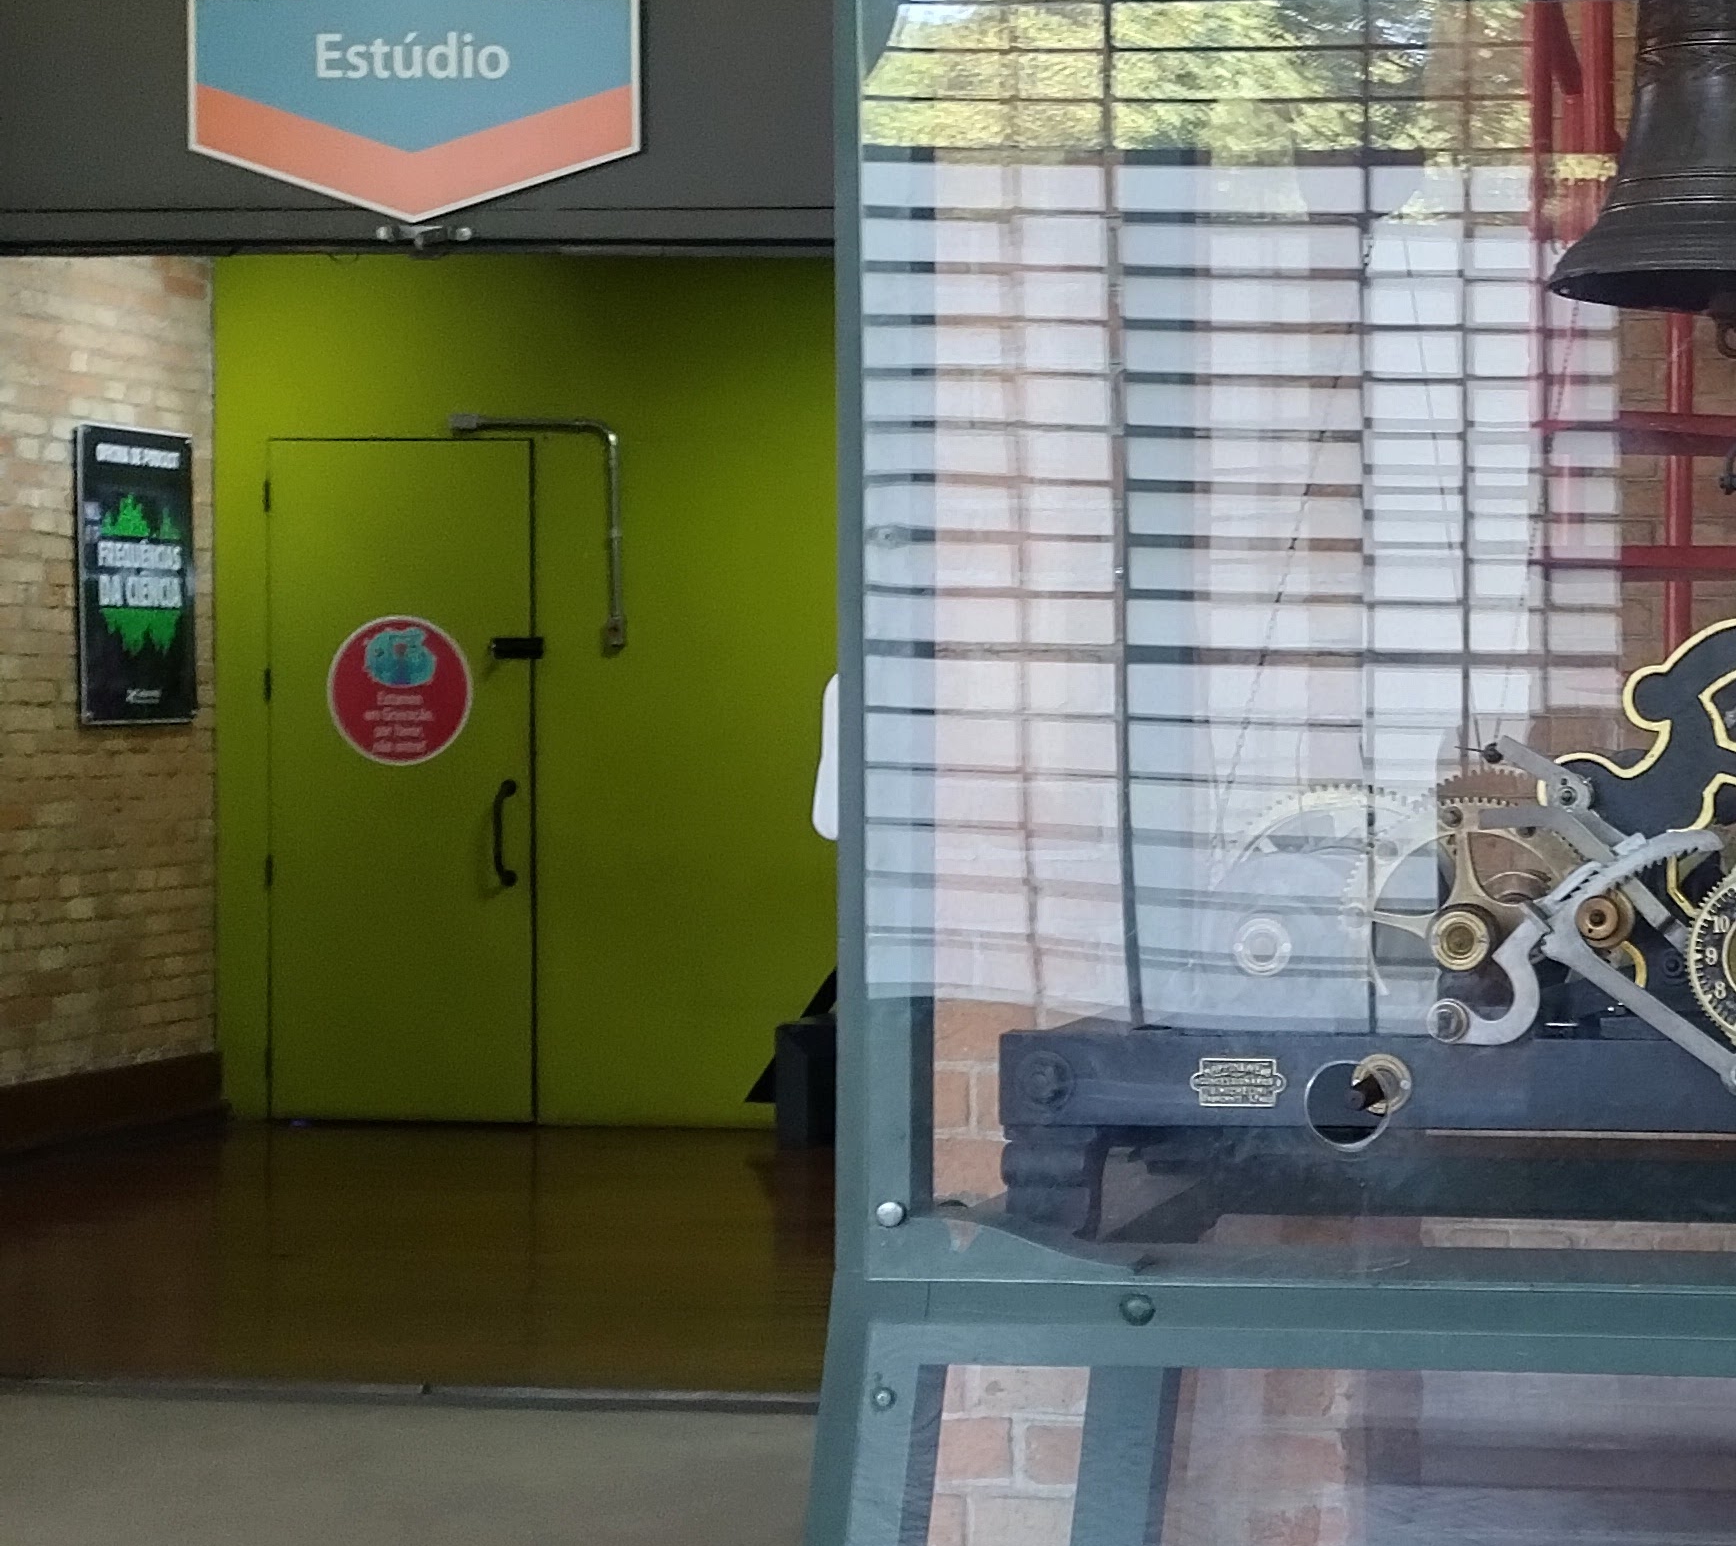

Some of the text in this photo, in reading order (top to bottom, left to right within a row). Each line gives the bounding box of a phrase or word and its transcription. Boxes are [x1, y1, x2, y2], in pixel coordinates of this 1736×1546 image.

[315, 30, 510, 80] Estúdio
[1712, 916, 1730, 934] 10
[1705, 947, 1718, 965] 9
[1714, 981, 1726, 999] 8
